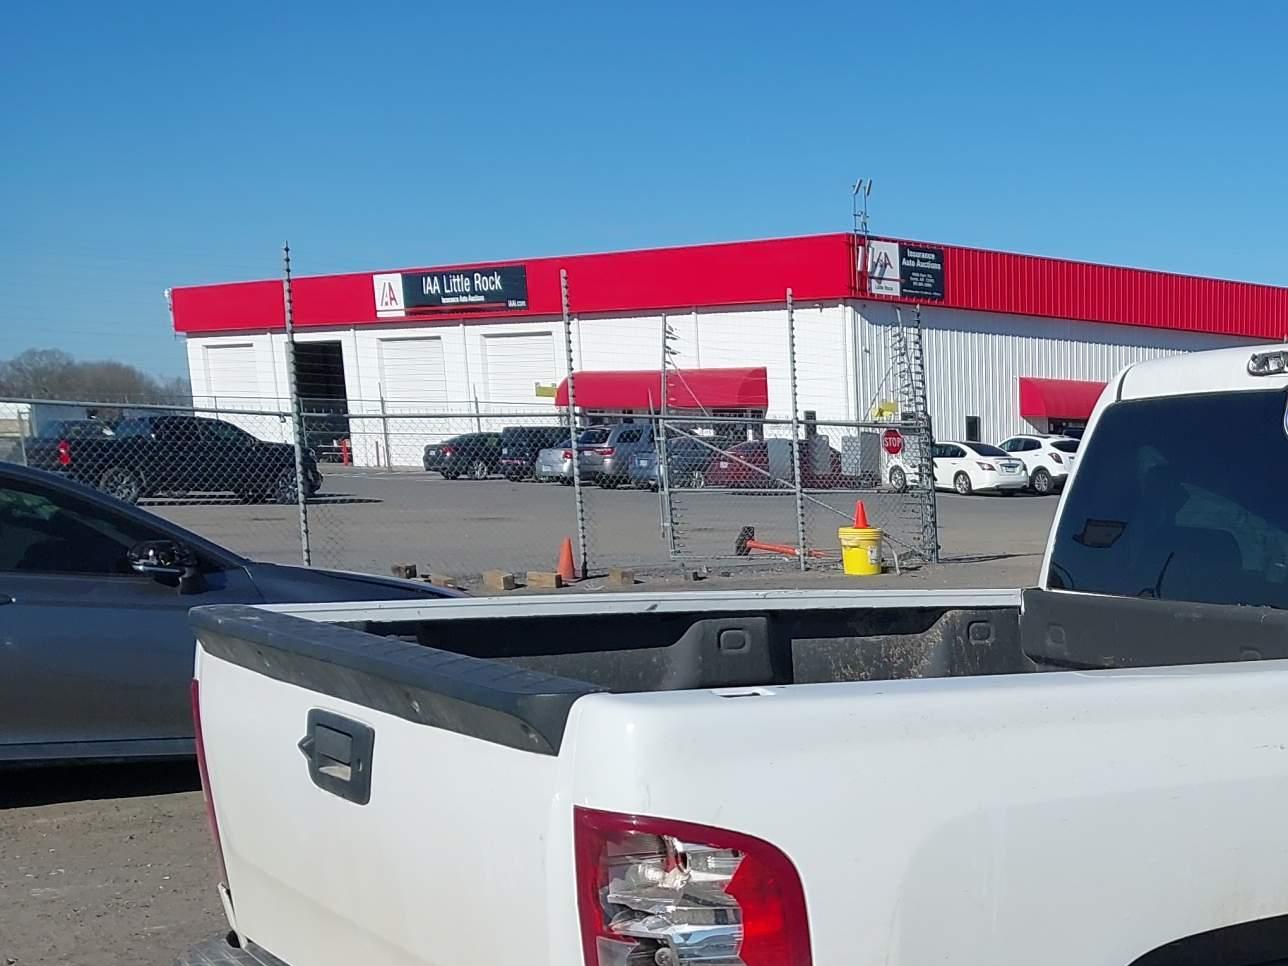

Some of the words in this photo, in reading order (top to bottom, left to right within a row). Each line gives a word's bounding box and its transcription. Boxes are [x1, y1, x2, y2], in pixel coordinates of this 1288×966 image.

[902, 258, 915, 267] Auto
[916, 259, 941, 270] Auctions
[422, 275, 441, 295] IAA
[443, 273, 470, 294] Little
[474, 271, 502, 292] Rock
[884, 437, 902, 448] STOP
